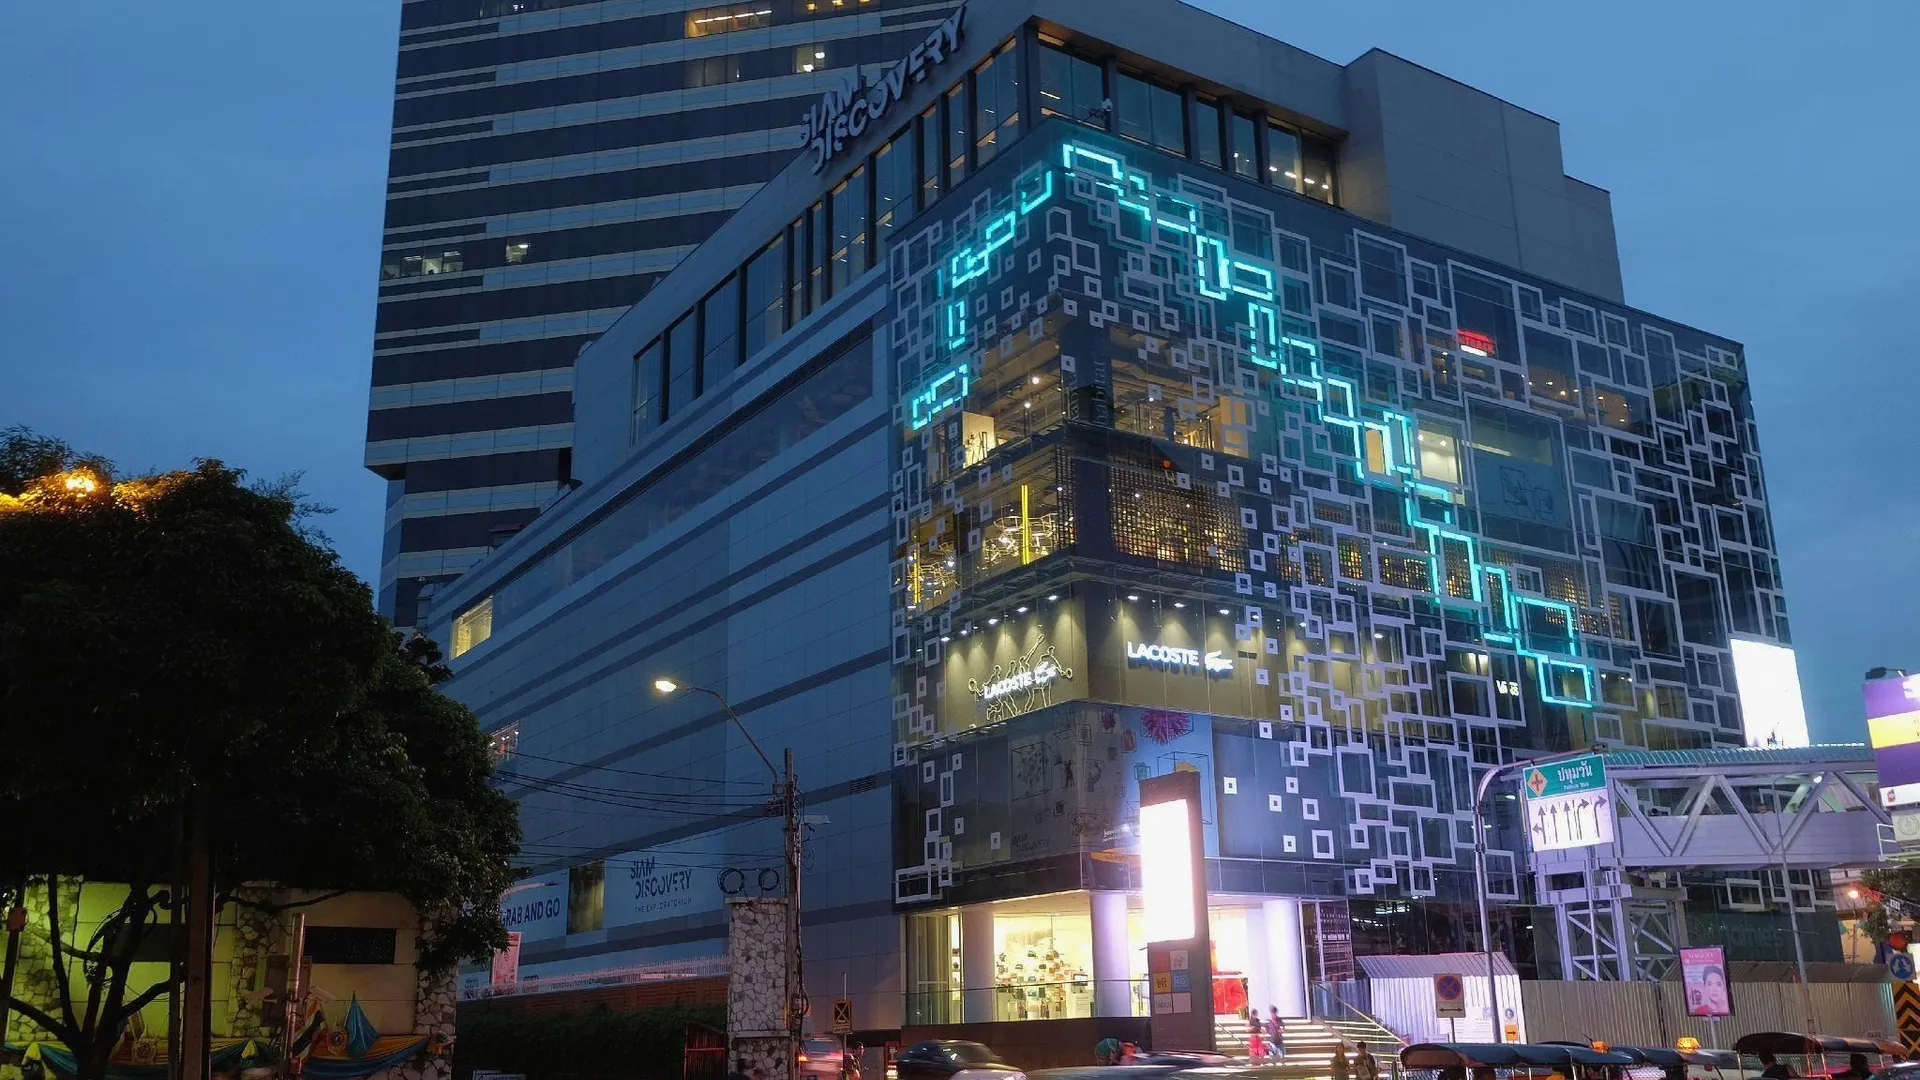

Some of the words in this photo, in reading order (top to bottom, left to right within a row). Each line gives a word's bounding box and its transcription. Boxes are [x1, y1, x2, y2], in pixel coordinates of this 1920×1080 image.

[811, 5, 966, 175] DISCOVERY
[797, 65, 862, 146] SIAM
[1127, 641, 1200, 667] LACOSTE
[983, 671, 1034, 700] LACOSTE
[1557, 760, 1593, 783] ปทุมวัน
[630, 856, 655, 879] SIAM
[635, 869, 692, 899] DISCOVERY
[524, 901, 544, 923] AND
[545, 897, 561, 918] GO
